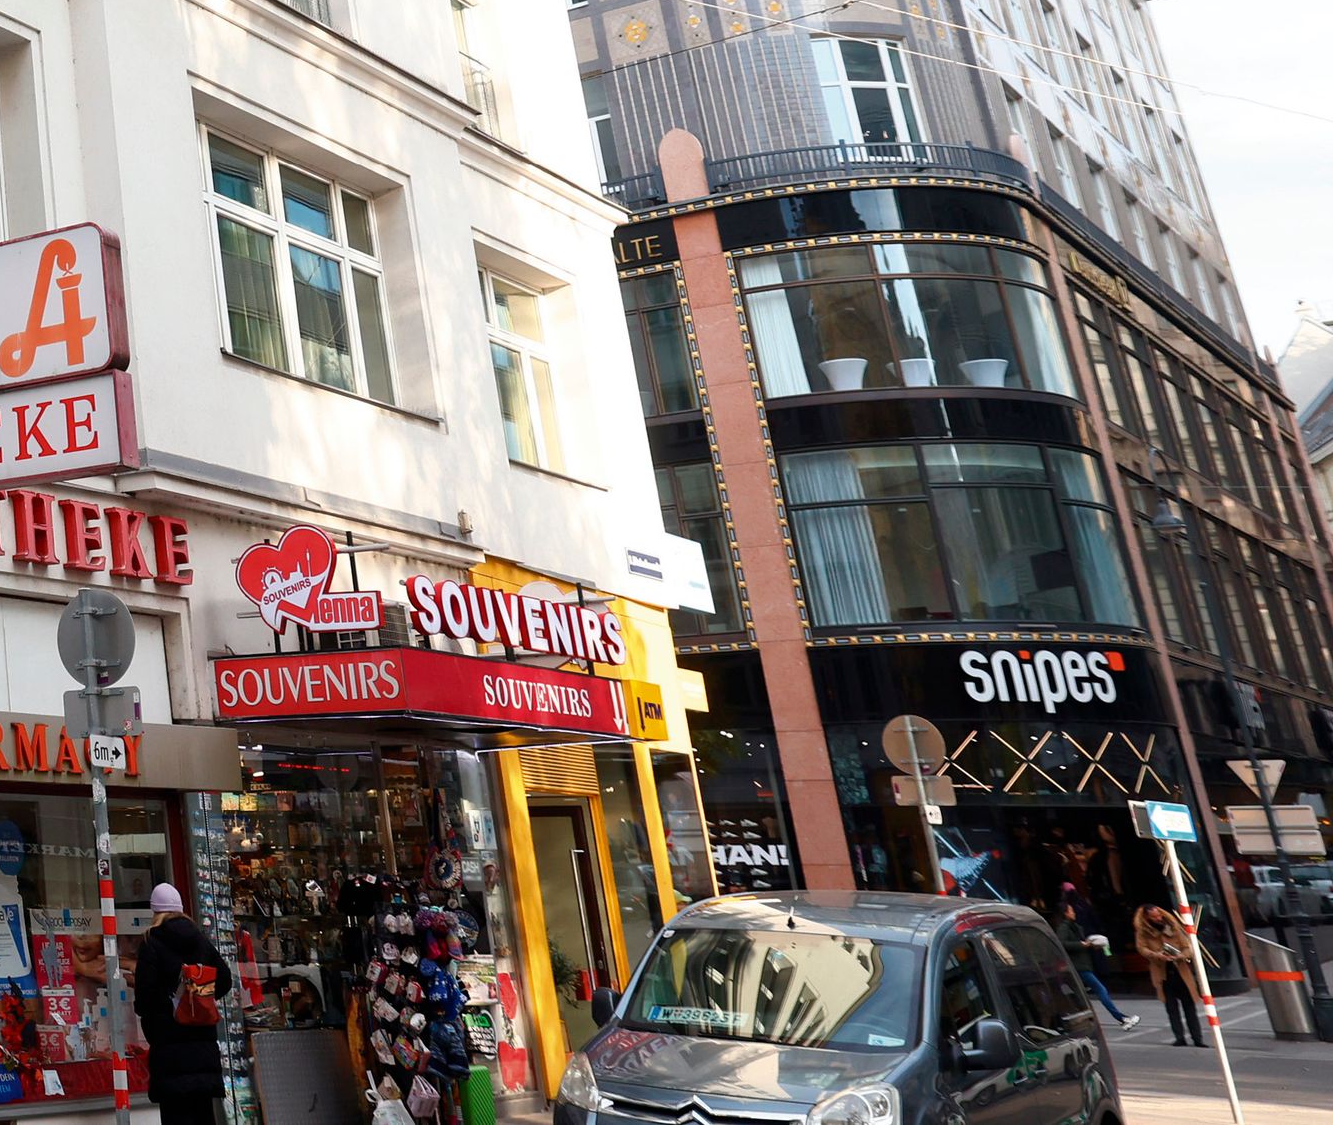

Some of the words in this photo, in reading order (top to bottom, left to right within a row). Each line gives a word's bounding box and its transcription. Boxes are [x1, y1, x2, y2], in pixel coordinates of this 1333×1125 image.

[615, 235, 663, 264] LTE
[263, 577, 312, 605] SOUVENIRS
[406, 574, 627, 666] SOUVENIRS
[220, 660, 400, 707] SOUVENIRS
[483, 674, 593, 718] SOUVENIRS
[959, 649, 1119, 714] snipes
[644, 701, 663, 720] ATM
[94, 741, 110, 761] 6m
